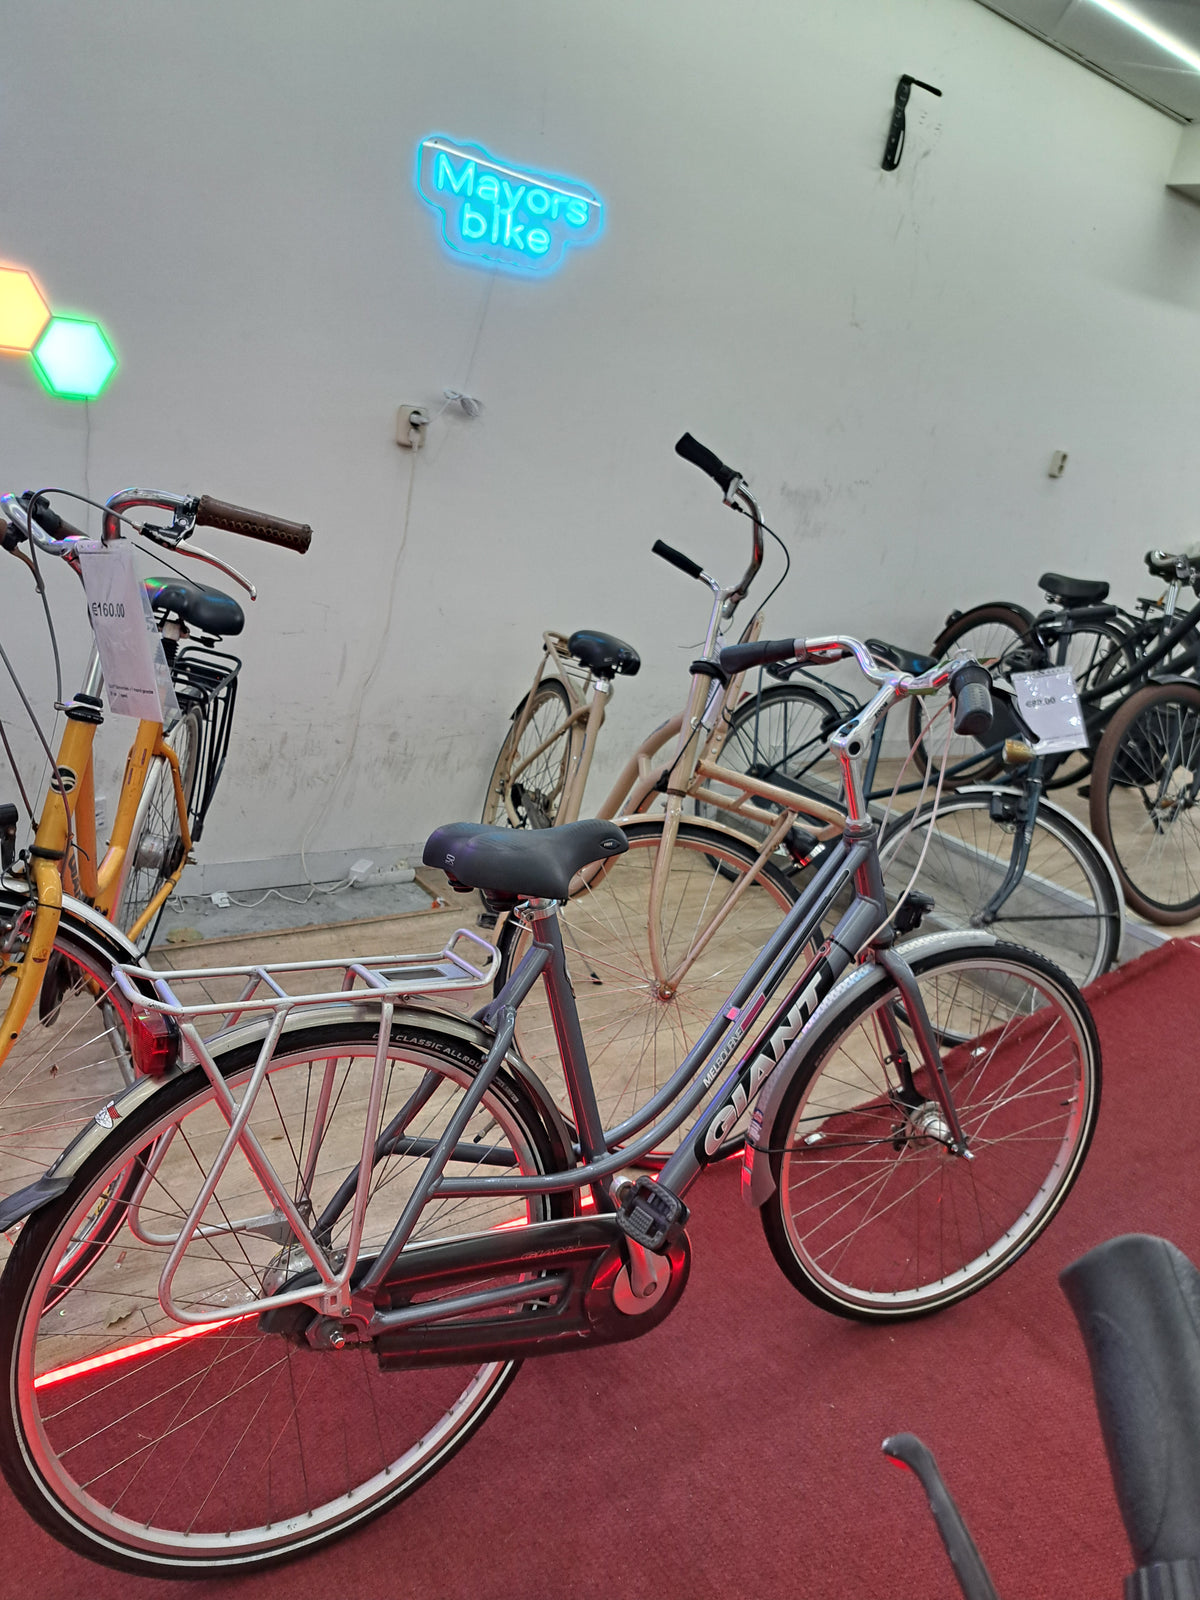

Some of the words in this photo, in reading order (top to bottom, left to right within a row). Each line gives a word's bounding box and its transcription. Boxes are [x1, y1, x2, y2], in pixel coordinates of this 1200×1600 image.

[437, 153, 588, 226] Mayors
[462, 202, 550, 254] bike
[91, 602, 125, 618] €160.00
[395, 1034, 443, 1051] CLASSIC
[443, 1047, 482, 1069] ALLROU
[702, 1028, 743, 1088] MELBOURNE
[704, 971, 823, 1156] GIANT
